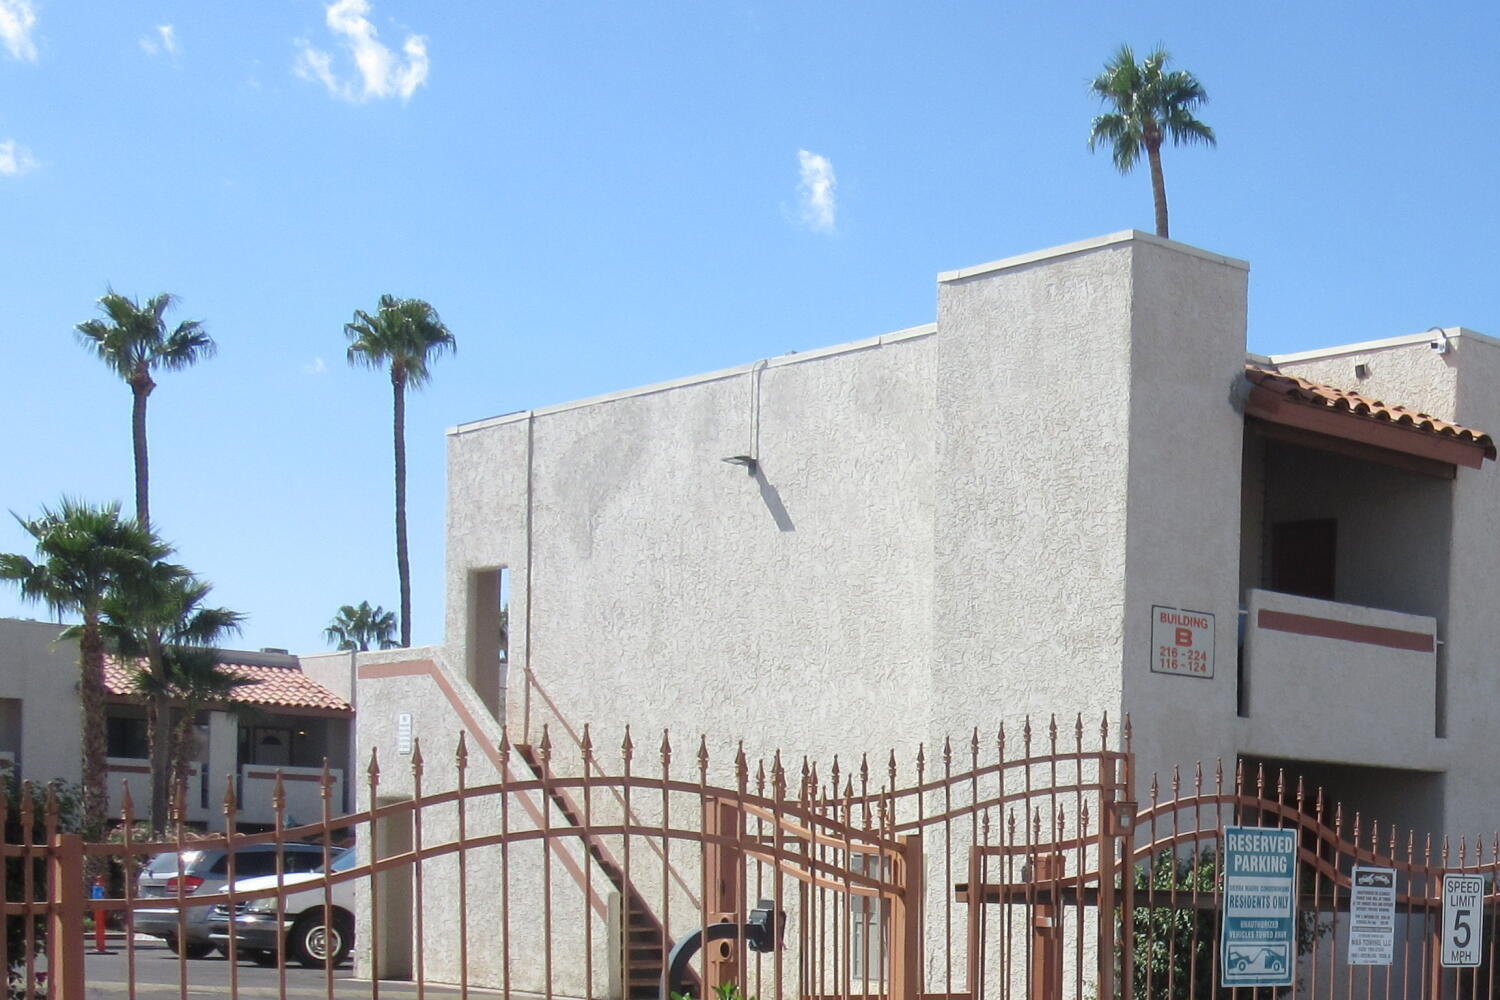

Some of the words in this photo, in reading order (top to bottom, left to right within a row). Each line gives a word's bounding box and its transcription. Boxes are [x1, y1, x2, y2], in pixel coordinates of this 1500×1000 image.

[1160, 611, 1208, 629] BUILDING
[1175, 627, 1193, 647] B
[1160, 646, 1178, 657] 216
[1187, 649, 1207, 661] 224
[1160, 658, 1178, 669] 116
[1188, 661, 1207, 672] 124
[1229, 834, 1293, 854] RESERVED
[1234, 855, 1287, 873] PARKING
[1447, 881, 1480, 893] SPEED
[1229, 895, 1271, 909] RESIDENTS
[1272, 896, 1289, 909] ONLY
[1450, 895, 1476, 907] LIMIT
[1240, 920, 1279, 929] UNAUTHORIZED
[1453, 910, 1471, 948] 5
[1229, 931, 1254, 939] VEHICLES
[1255, 931, 1274, 939] TOWED
[1451, 951, 1472, 961] MPH
